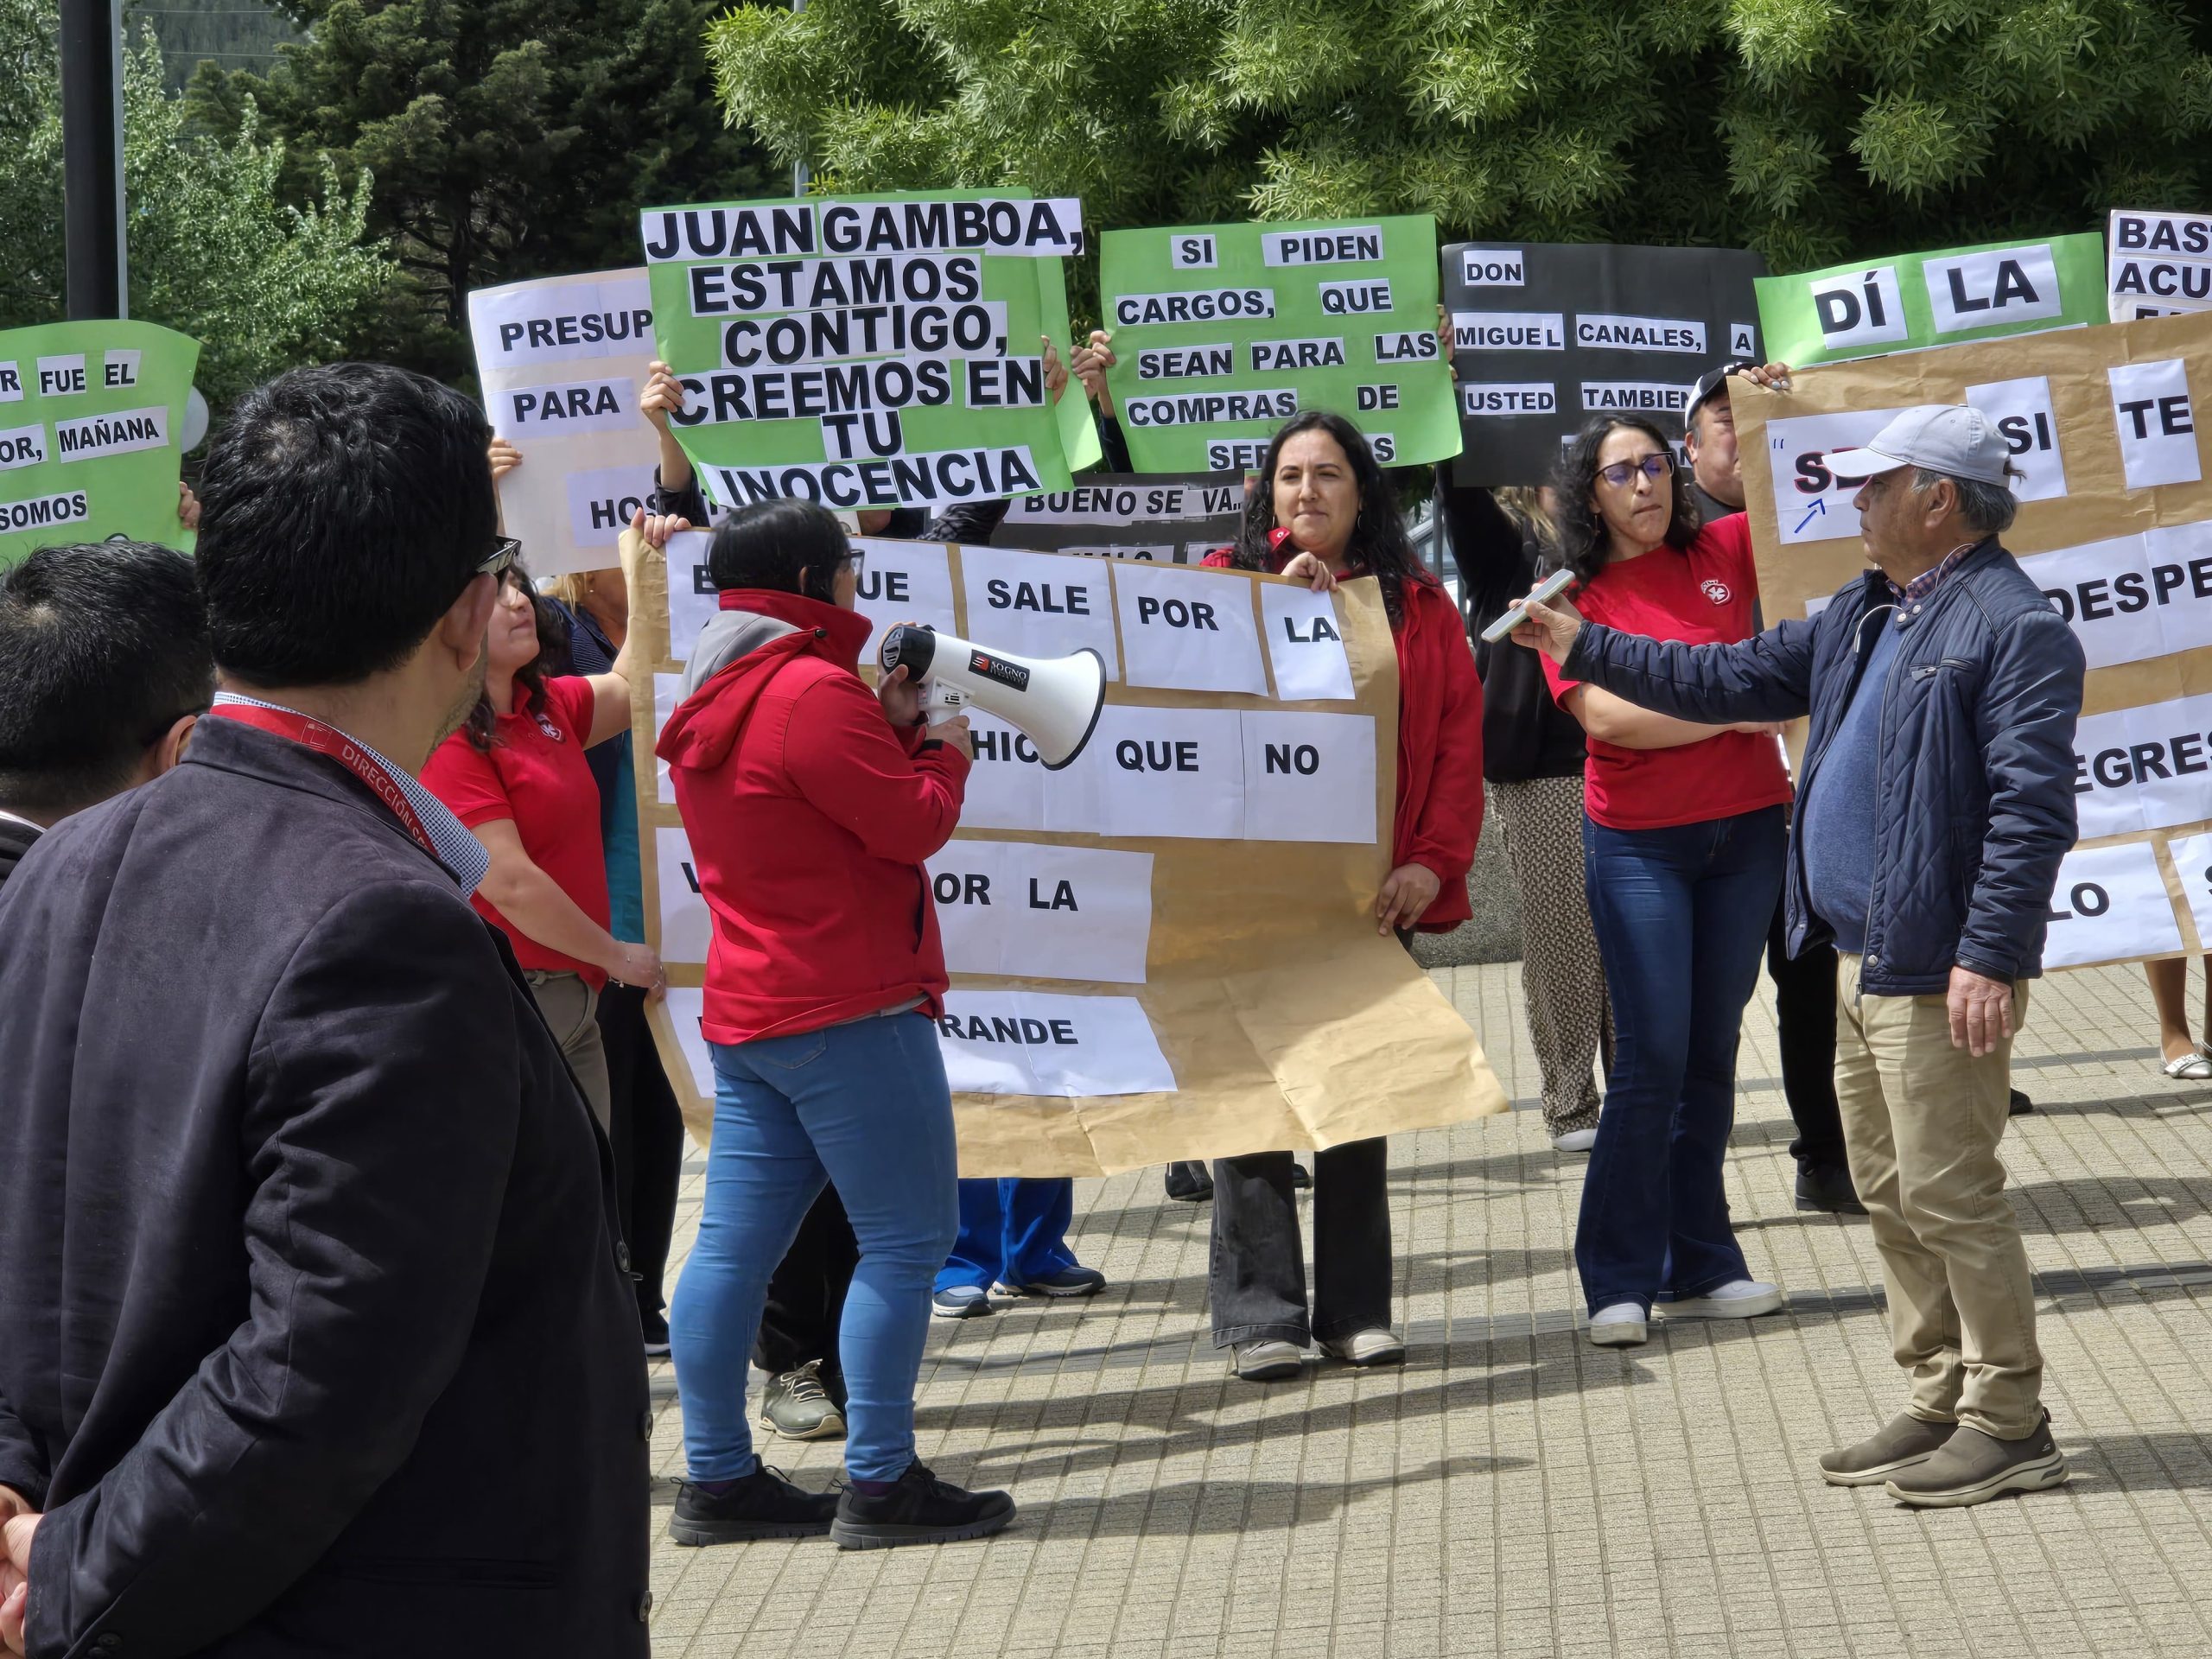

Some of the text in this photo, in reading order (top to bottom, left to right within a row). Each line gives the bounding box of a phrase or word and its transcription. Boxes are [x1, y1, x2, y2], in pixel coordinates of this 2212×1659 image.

[646, 202, 1084, 258] JUAN GAMBOA,
[1181, 235, 1378, 264] SI PIDEN
[2119, 217, 2212, 253] BAS
[692, 257, 979, 314] ESTAMOS
[1466, 263, 1522, 282] DON
[2114, 262, 2211, 299] ACU
[1117, 286, 1392, 326] CARGOS, QUE
[1815, 259, 2039, 334] DÍ LA
[499, 309, 653, 352] PRESUP
[724, 304, 1007, 368] CONTIGO,
[1455, 322, 1751, 353] MIGUEL CANALES, A
[1139, 333, 1437, 379] SEAN PARA LAS
[40, 368, 86, 393] FUE
[105, 363, 135, 385] EL
[672, 359, 1044, 426] CREEMOS EN
[512, 385, 620, 423] PARA
[1128, 385, 1399, 426] COMPRAS DE
[1467, 391, 1554, 410] USTED
[58, 417, 159, 453] MAÑANA
[822, 410, 904, 459] TU
[1997, 411, 2052, 455] SI
[2119, 395, 2194, 440] TE
[719, 449, 1039, 505] INOCENCIA
[0, 494, 87, 531] SOMOS
[1024, 487, 1136, 515] BUENO
[1146, 489, 1184, 514] SE
[855, 570, 910, 602] UE
[987, 579, 1090, 615] SALE
[1138, 596, 1219, 631] POR
[1285, 616, 1341, 643] LA
[970, 729, 1319, 776] HIC QUE NO
[341, 744, 413, 828] DIRECCIÓN
[933, 872, 1079, 912] OR LA
[936, 1014, 1079, 1045] RANDE
